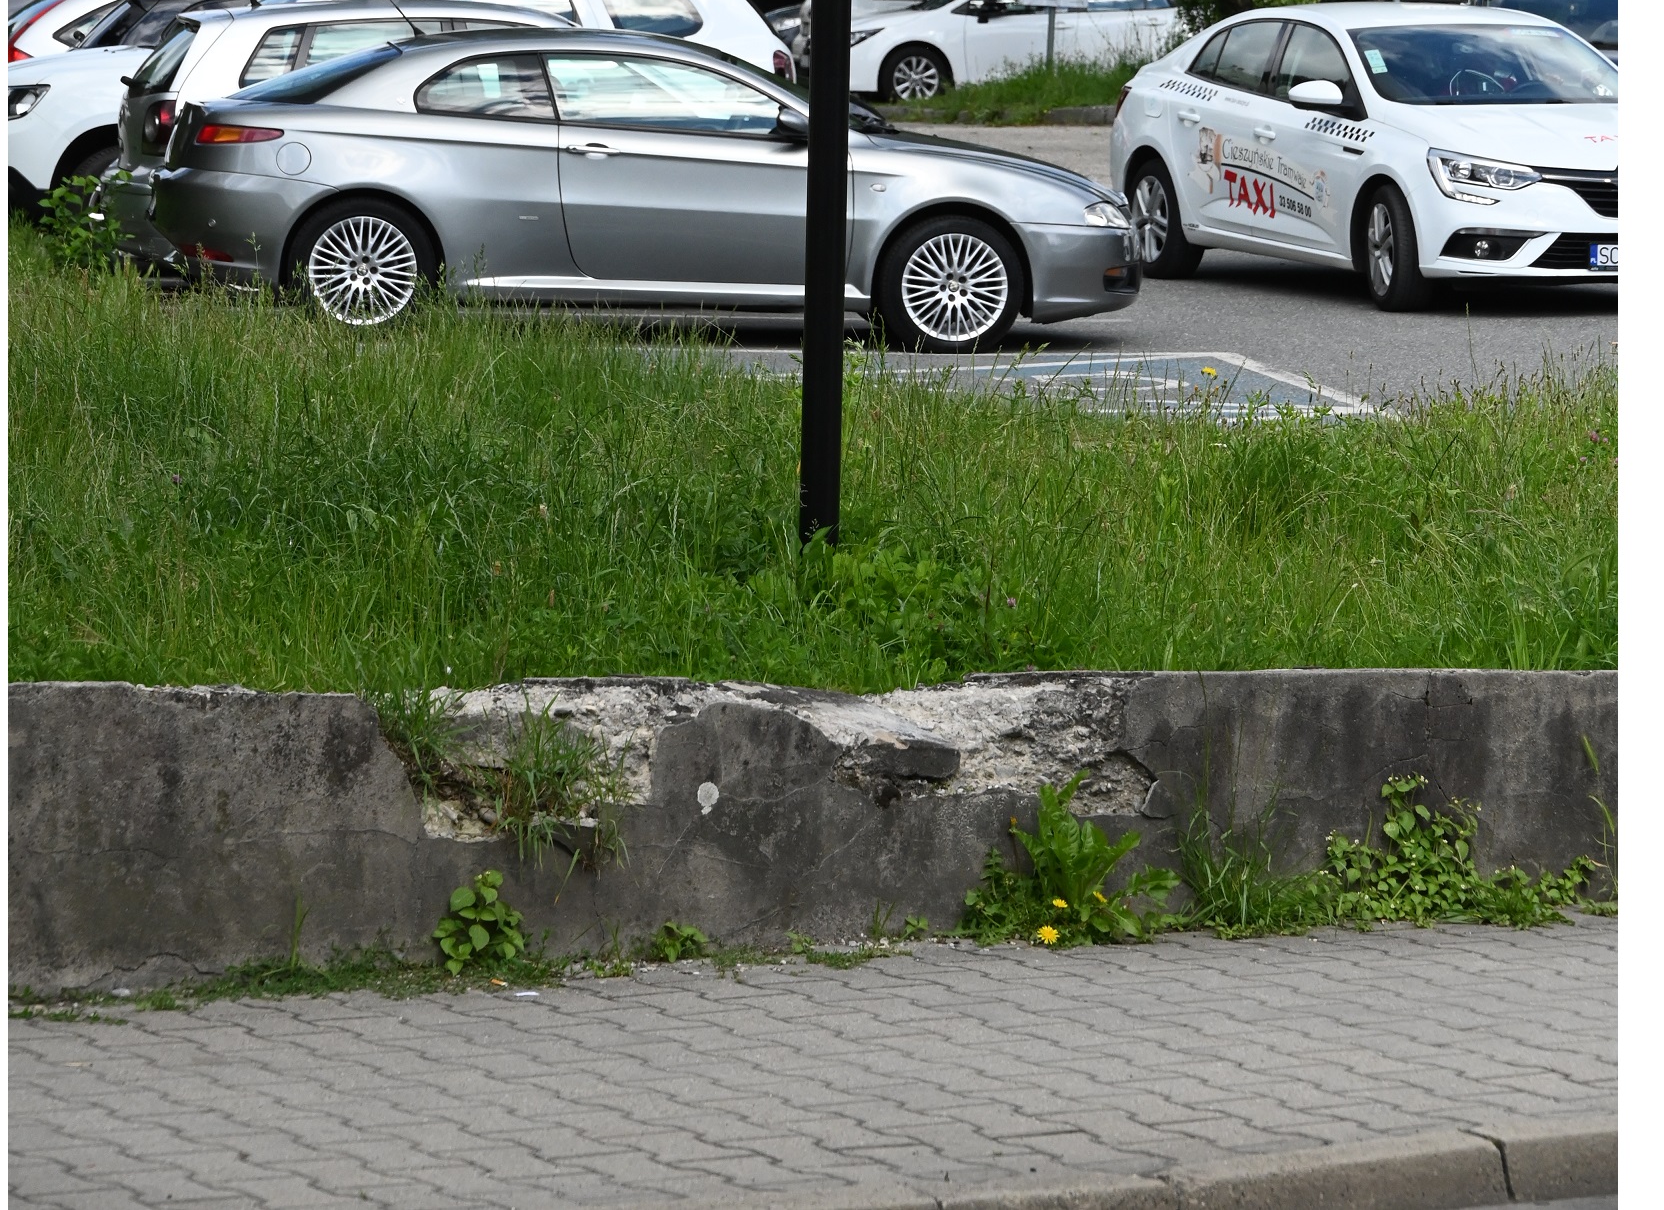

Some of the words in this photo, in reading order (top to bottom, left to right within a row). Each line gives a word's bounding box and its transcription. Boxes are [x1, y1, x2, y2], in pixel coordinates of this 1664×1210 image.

[1223, 169, 1276, 219] TAXI
[1279, 194, 1286, 206] 33
[1286, 197, 1296, 213] 506
[1297, 201, 1304, 215] 58
[1304, 204, 1312, 218] 00
